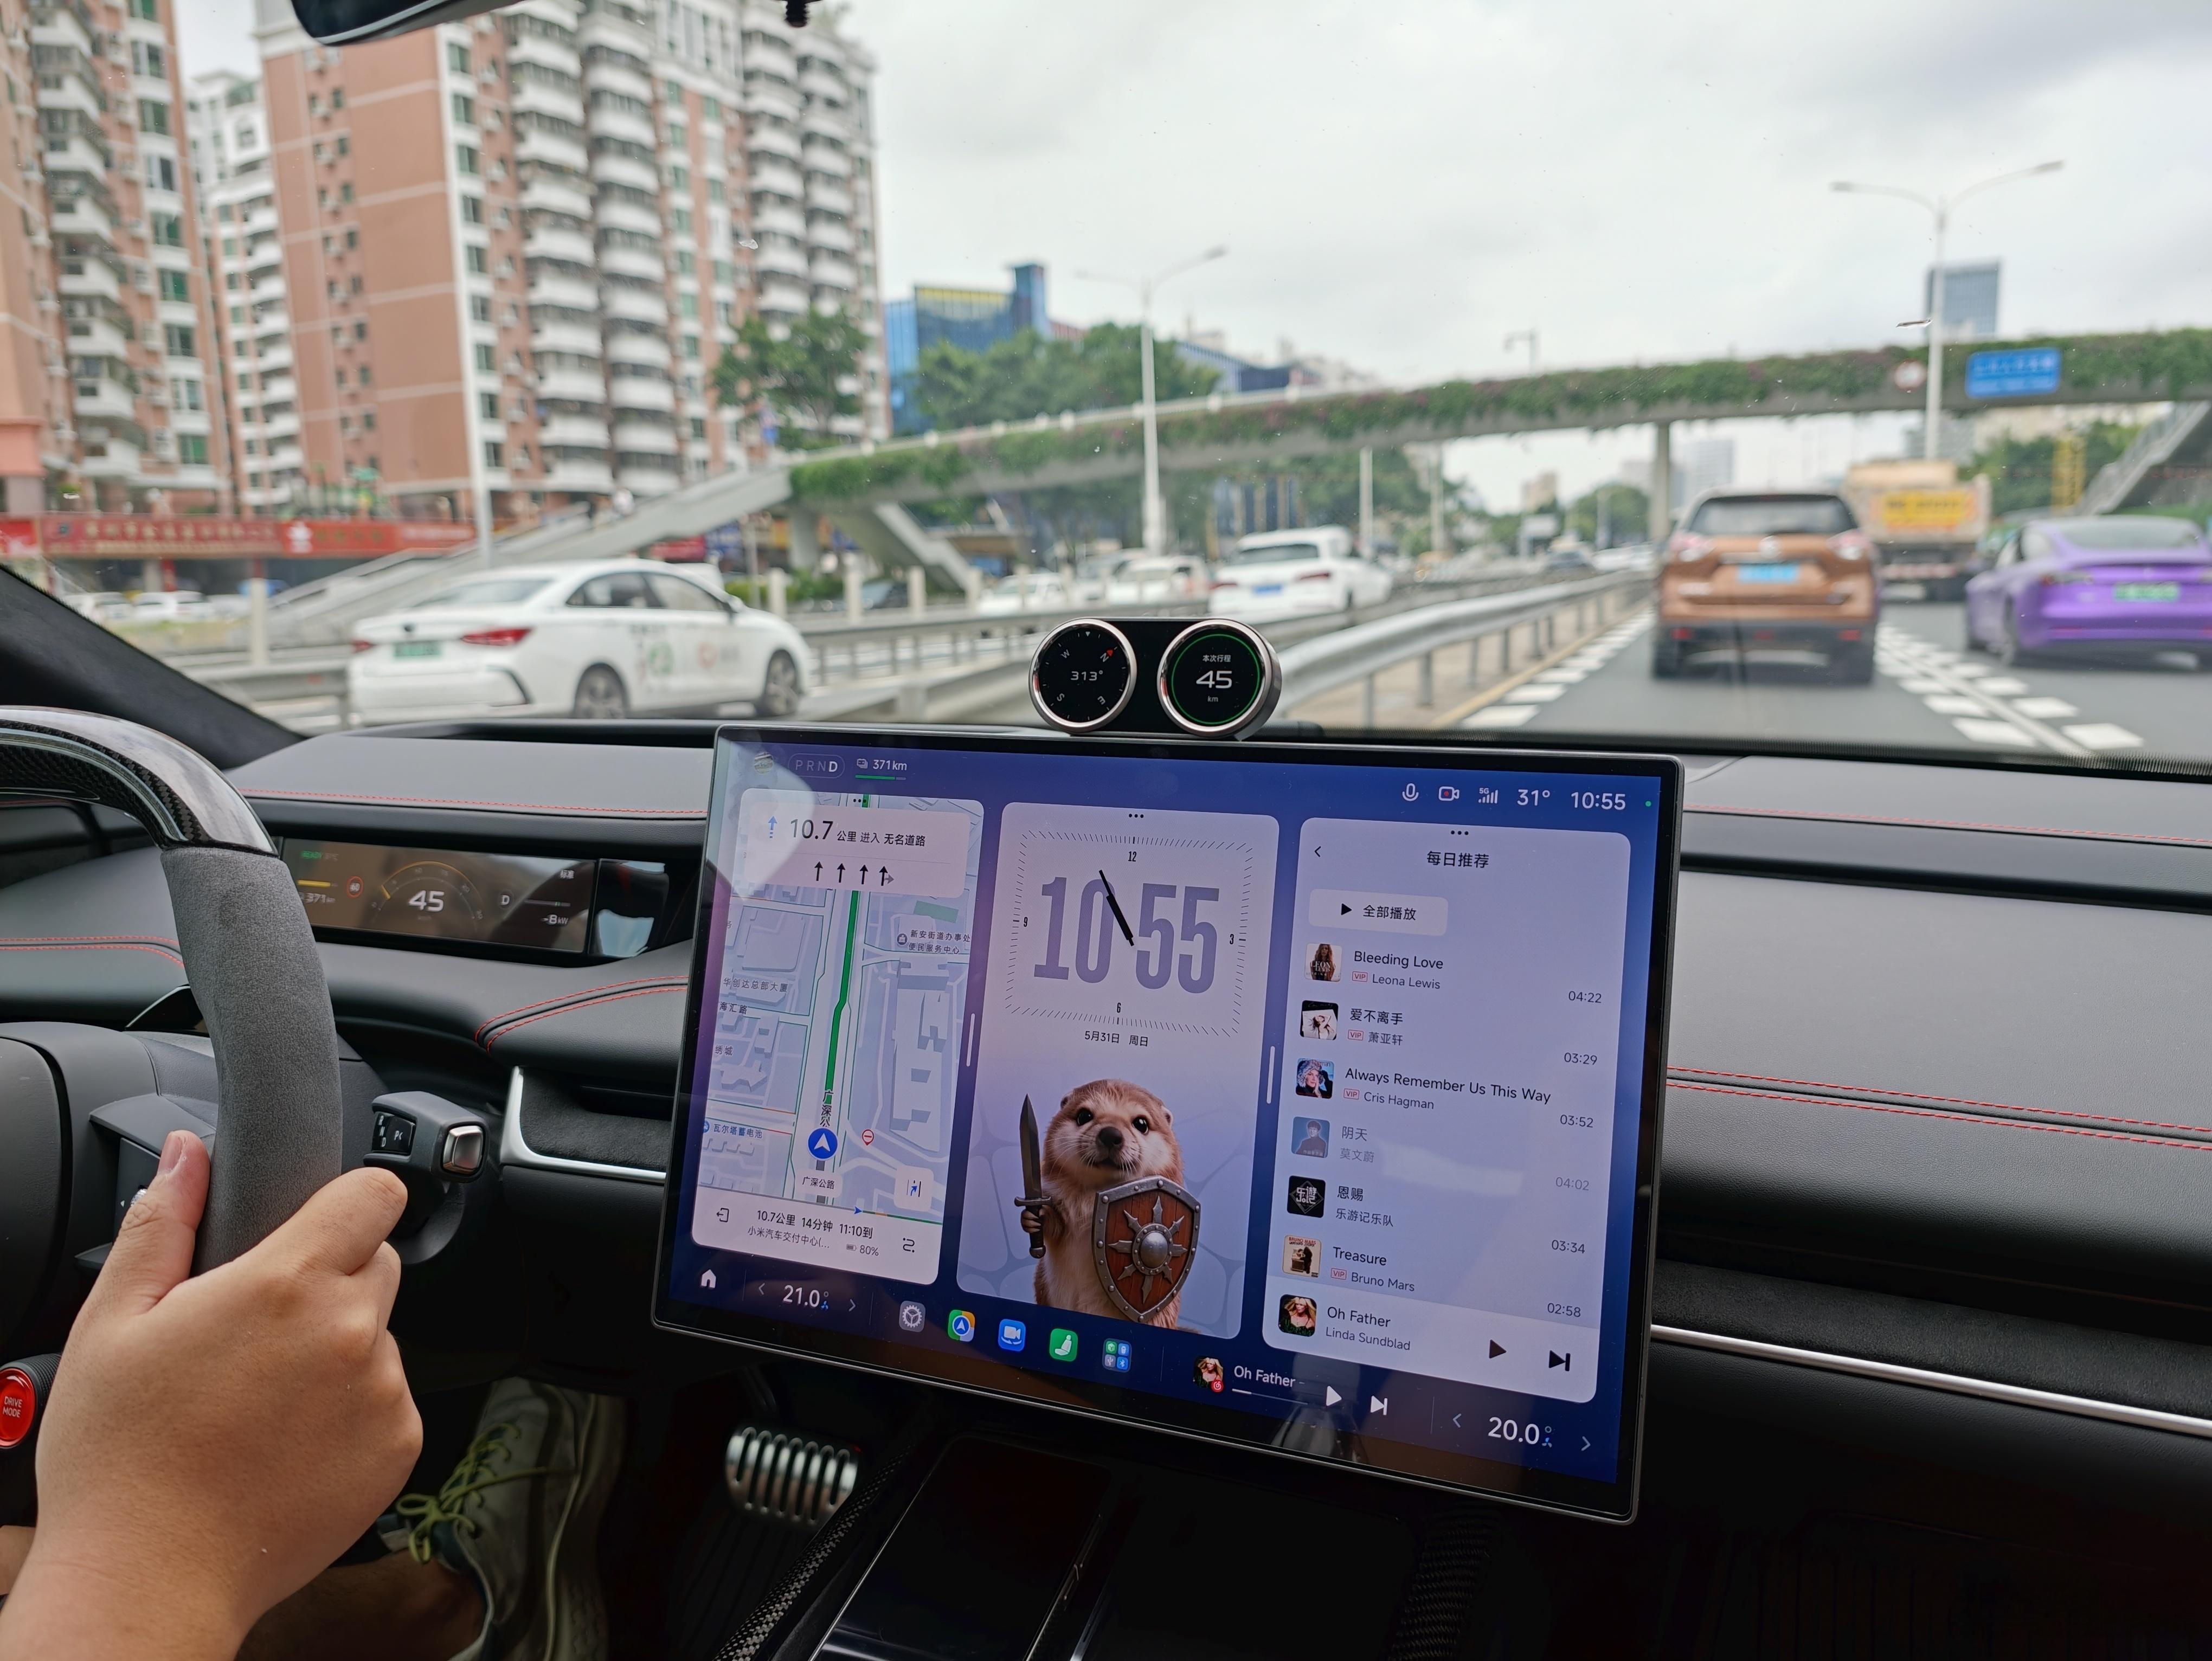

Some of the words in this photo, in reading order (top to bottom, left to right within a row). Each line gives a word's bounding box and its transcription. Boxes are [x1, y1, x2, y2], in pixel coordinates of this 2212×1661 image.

[1099, 652, 1109, 662] N
[1203, 654, 1231, 662] 本次行程
[1196, 670, 1232, 688] 45
[1517, 789, 1551, 806] 31°
[1571, 792, 1626, 810] 10:55
[790, 819, 833, 840] 10.7
[837, 830, 857, 842] 公里
[860, 832, 880, 843] 进入
[884, 833, 925, 847] 无名道路
[1128, 851, 1137, 862] 12
[1426, 850, 1490, 868] 每日推荐
[408, 890, 445, 912] 45
[501, 895, 510, 905] D
[1362, 904, 1417, 921] 全部播放
[1023, 917, 1028, 928] 9
[910, 929, 970, 943] 新安街道办事处
[1034, 877, 1115, 983] 10
[1136, 883, 1220, 994] 55
[1230, 933, 1234, 945] 3
[909, 942, 960, 955] 便民服务中心
[1354, 951, 1410, 969] Bleeding
[1413, 956, 1444, 970] Love
[723, 977, 788, 993] 华创达总部大厦
[1354, 973, 1366, 981] VIP
[1372, 974, 1406, 987] Leona
[1409, 976, 1441, 989] Lewis
[1568, 990, 1602, 1004] 04:22
[719, 1002, 747, 1014] 海汇路
[1116, 1002, 1121, 1013] 6
[1349, 1008, 1403, 1025] 爱不离手
[1084, 1031, 1120, 1044] 5月31日
[1129, 1035, 1149, 1047] 周日
[1368, 1031, 1403, 1046] 萧亚轩
[1564, 1052, 1598, 1066] 03:29
[1345, 1067, 1390, 1085] Always
[1394, 1073, 1464, 1092] Remember
[1469, 1082, 1486, 1095] Us
[1490, 1084, 1517, 1099] This
[1522, 1088, 1551, 1105] Way
[1364, 1091, 1385, 1104] Cris
[1388, 1094, 1435, 1110] Hagman
[378, 1115, 384, 1125] R
[1560, 1114, 1593, 1128] 03:52
[380, 1126, 385, 1136] N
[713, 1123, 763, 1139] 瓦尔塔蓄电池
[1342, 1126, 1367, 1141] 阴天
[381, 1137, 387, 1148] D
[1340, 1148, 1375, 1163] 莫文蔚
[802, 1176, 835, 1190] 广深公路
[1555, 1176, 1590, 1192] 04:02
[1337, 1186, 1364, 1201] 恩赐
[757, 1210, 796, 1226] 10.7公里
[802, 1217, 833, 1233] 14分钟
[840, 1224, 873, 1239] 11:10到
[1335, 1208, 1393, 1227] 乐游记乐队
[860, 1245, 879, 1257] 80%
[1551, 1239, 1585, 1254] 03:34
[1333, 1246, 1387, 1266] Treasure
[1333, 1270, 1345, 1278] VIP
[1351, 1272, 1384, 1287] Bruno
[1388, 1278, 1415, 1292] Mars
[1327, 1306, 1346, 1321] Oh
[1350, 1310, 1391, 1328] Father
[1547, 1302, 1581, 1318] 02:58
[1326, 1327, 1355, 1341] Linda
[1358, 1331, 1411, 1351] Sundblad
[1234, 1365, 1252, 1380] Oh
[1256, 1369, 1296, 1387] Father
[4, 1396, 23, 1408] DRIVE
[2, 1406, 21, 1418] MODE
